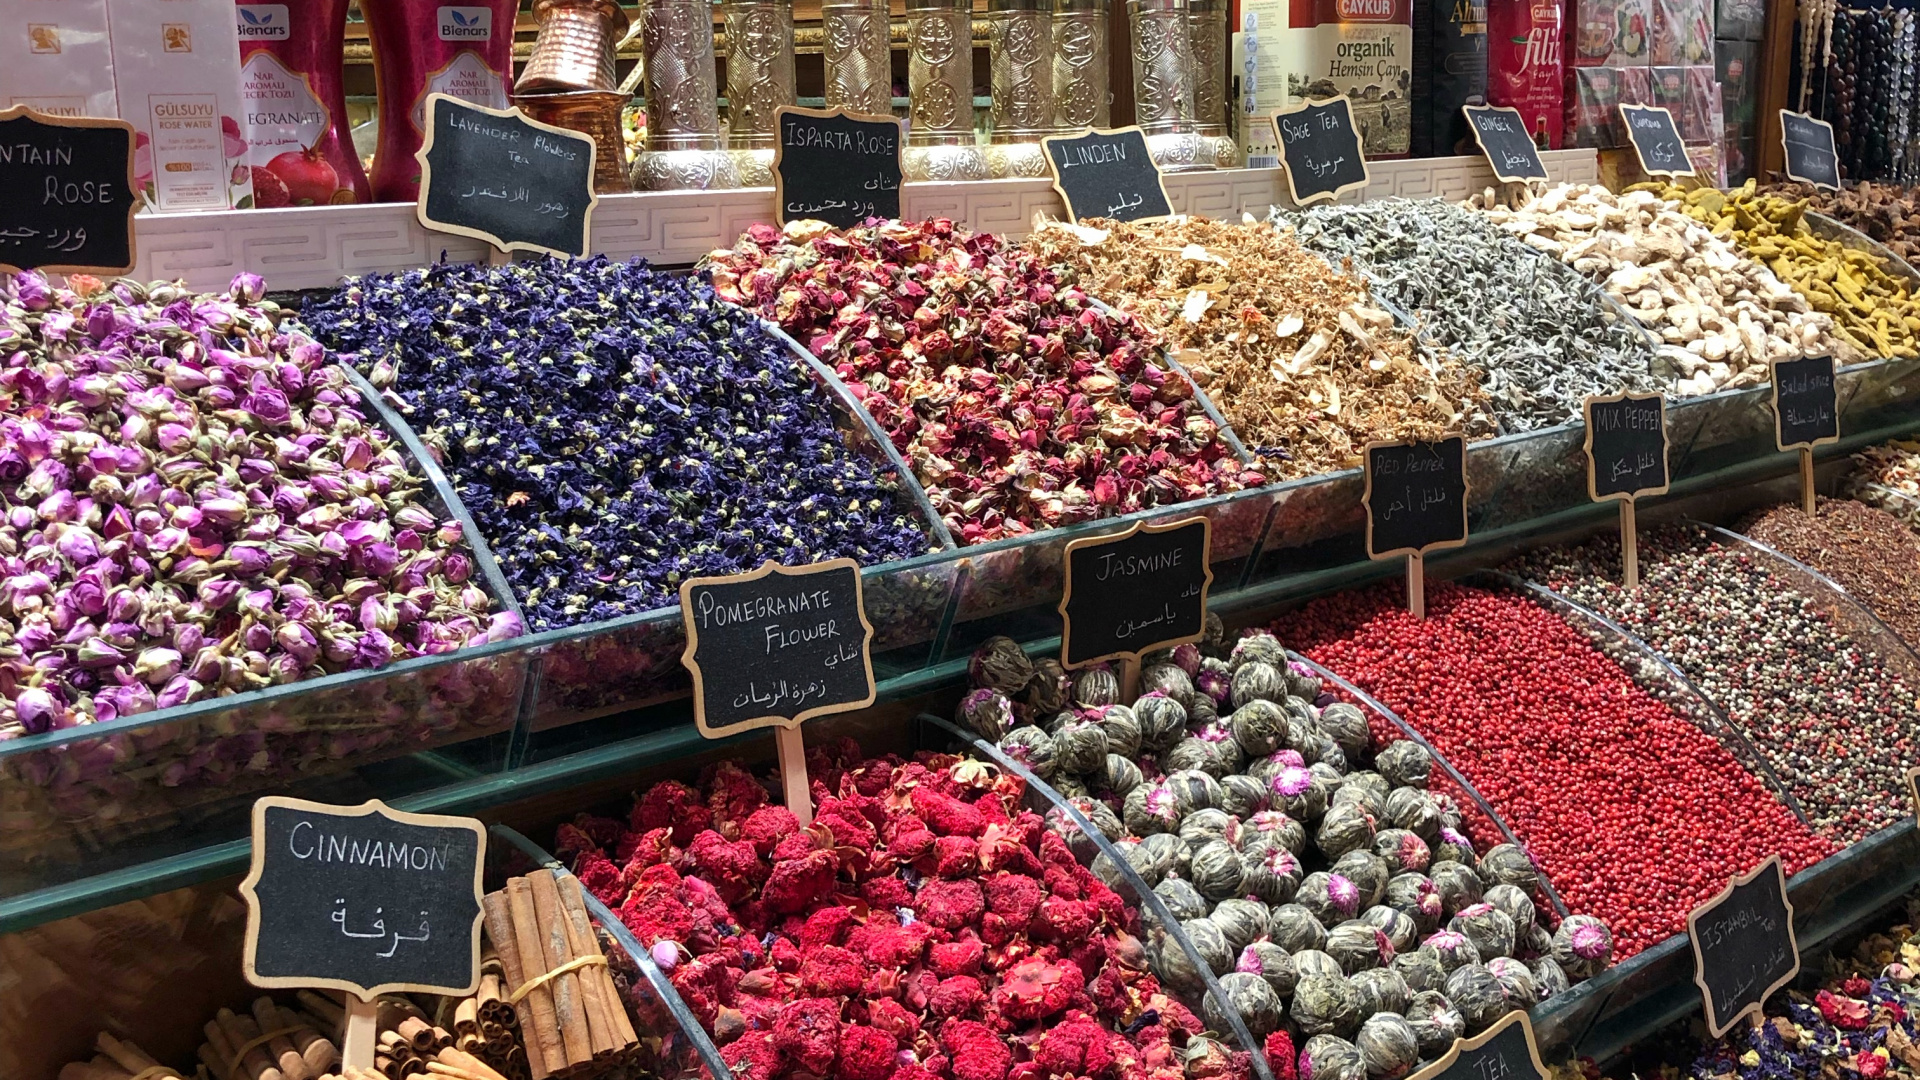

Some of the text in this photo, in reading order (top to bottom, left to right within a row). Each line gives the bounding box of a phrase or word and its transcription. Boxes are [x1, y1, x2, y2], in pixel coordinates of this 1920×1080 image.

[442, 25, 488, 36] Bienars
[1337, 36, 1395, 62] organik
[253, 72, 275, 81] NAR
[449, 80, 487, 88] AROMALI
[460, 71, 478, 79] NAR
[1329, 60, 1401, 82] Hemşin Çayı
[243, 82, 285, 90] AROMALI
[269, 90, 295, 99] TOZU
[154, 102, 214, 117] GÜLSUYU
[159, 121, 213, 130] ROSE WATER
[450, 113, 521, 143] LAVENDER
[533, 135, 577, 161] Flowers
[1282, 111, 1340, 144] SAGE TEA
[1477, 115, 1514, 133] GINGER
[785, 122, 893, 156] ISPARTA ROSE
[508, 150, 530, 168] Tea
[1061, 142, 1127, 169] LINDEN
[43, 175, 114, 206] ROSE
[534, 201, 570, 219] زهور
[46, 227, 88, 251] ورد
[1596, 406, 1661, 432] MIX PEPPER
[1375, 453, 1446, 477] RED PEPPER
[1635, 451, 1655, 476] فلفل
[1420, 487, 1447, 512] فلفل
[1096, 547, 1183, 581] JASMINE
[698, 590, 832, 629] POMEGRANATE
[1115, 602, 1177, 639] ياسمين
[764, 619, 841, 655] FLOWER
[824, 643, 858, 670] شاي
[792, 680, 826, 706] زهرة
[289, 821, 450, 872] CINNAMON
[331, 898, 431, 958] قرفة
[1703, 906, 1762, 950] ISTANBUL
[1472, 1051, 1511, 1080] TEA
